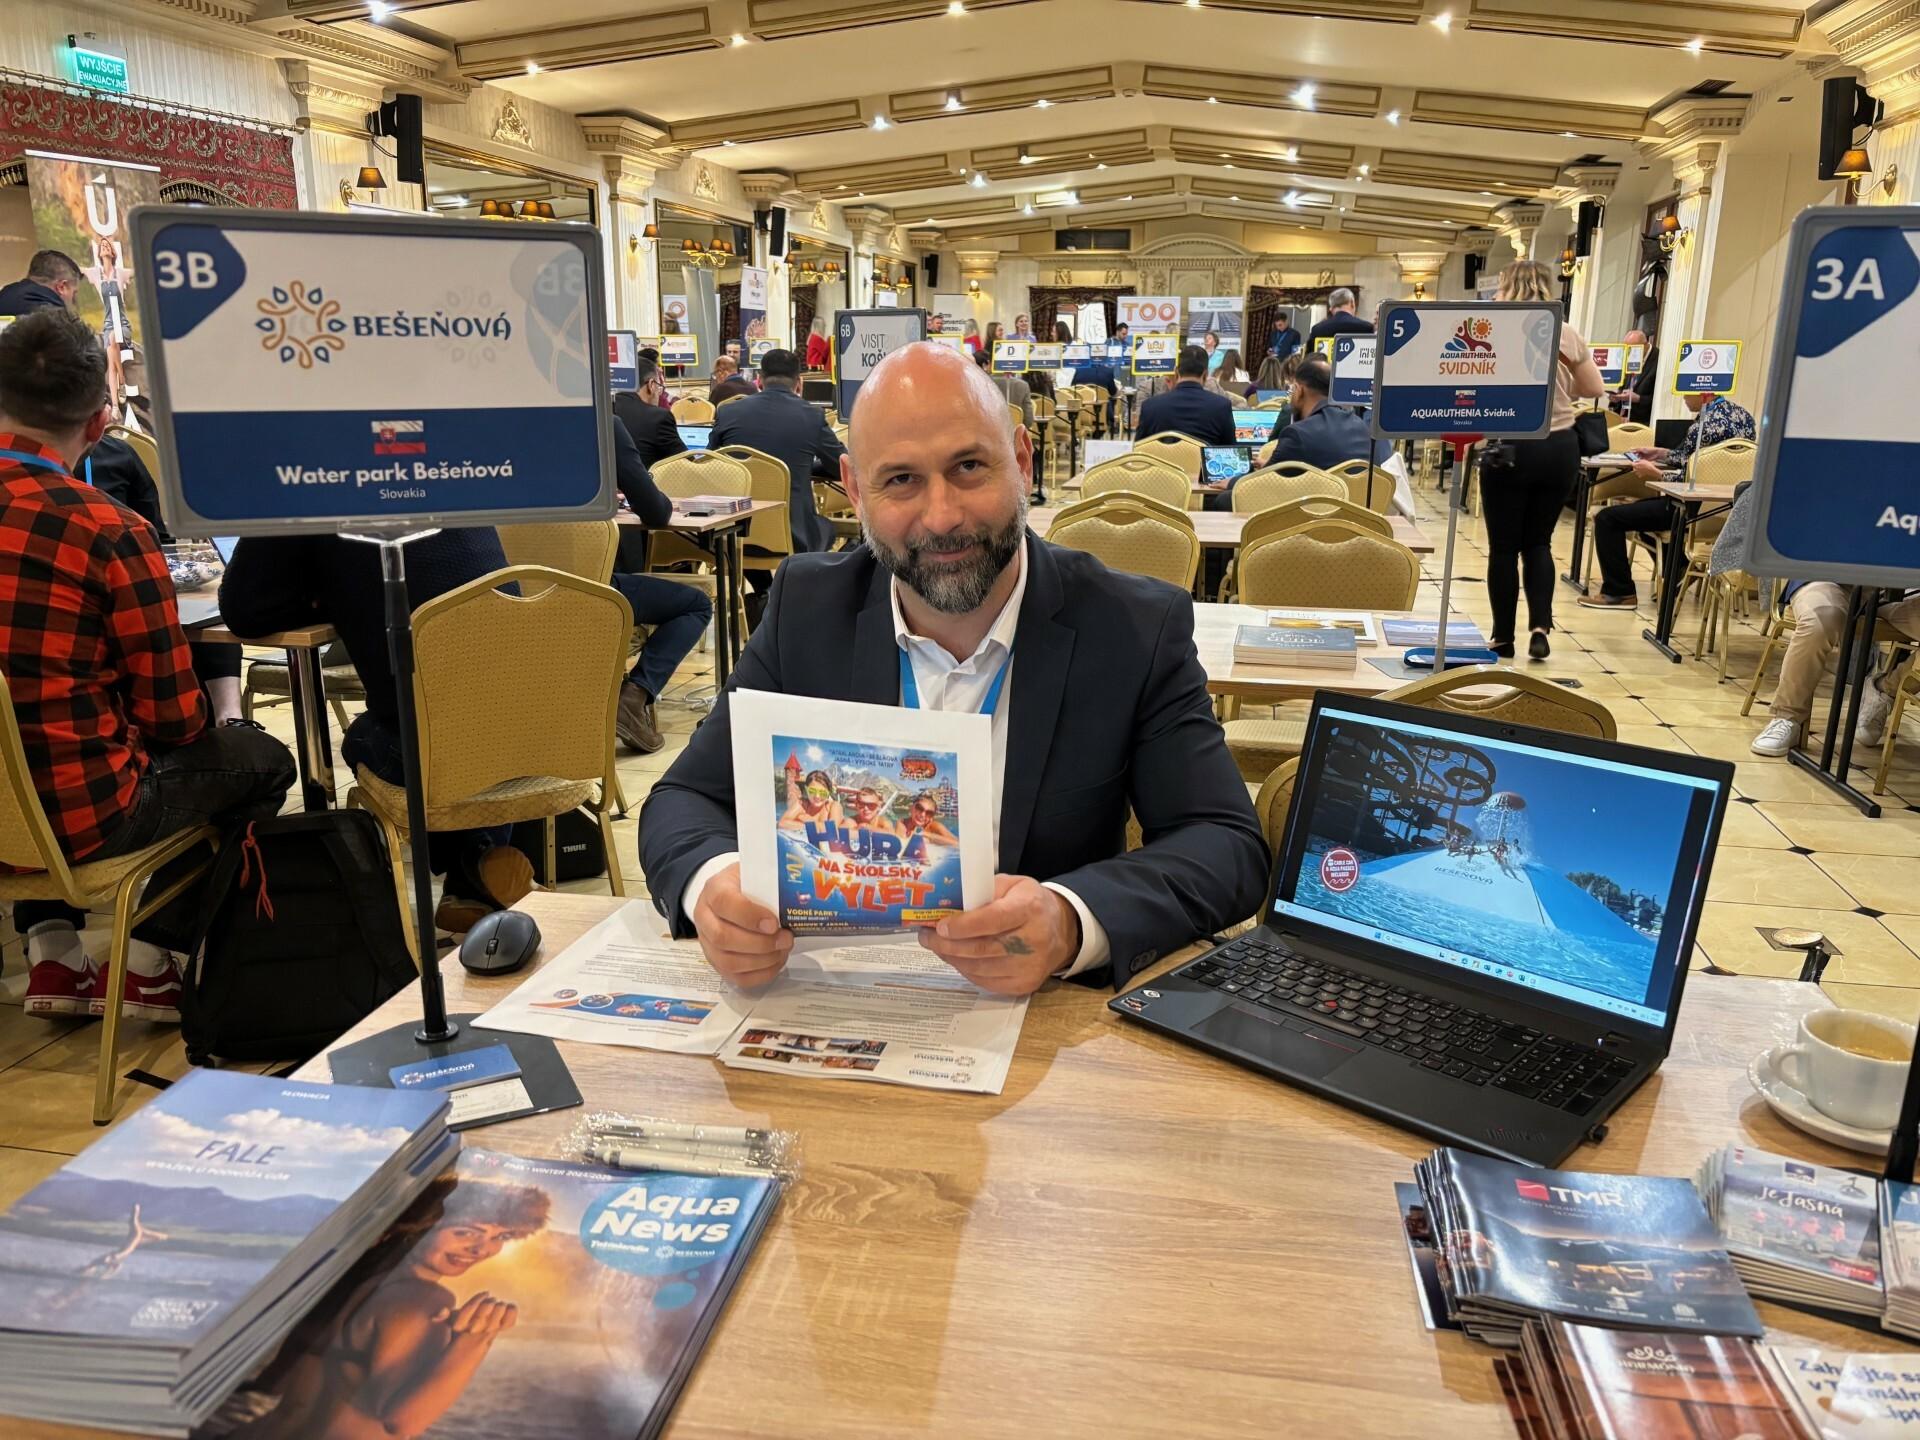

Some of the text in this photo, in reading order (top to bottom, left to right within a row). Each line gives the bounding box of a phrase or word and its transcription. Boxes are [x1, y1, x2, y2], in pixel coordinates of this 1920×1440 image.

[79, 55, 123, 76] WYJŚCIE
[156, 251, 219, 290] 3B
[1811, 258, 1885, 300] 3A
[353, 310, 512, 342] BEŠEŇOVÁ
[841, 324, 851, 337] 6B
[1392, 320, 1404, 337] 5
[861, 334, 885, 348] VISIT
[1339, 343, 1350, 352] 10
[862, 349, 887, 367] KOŠ
[1439, 359, 1496, 375] SVIDNÍK
[1411, 408, 1516, 418] AQUARUTHENIA Svidník
[276, 460, 513, 488] Water park Bešeňová
[379, 487, 427, 500] Slovakia
[562, 844, 587, 853] THULE
[805, 820, 929, 865] HURÁ
[819, 858, 922, 881] NA ŠKOLSKÝ
[813, 870, 935, 912] VÝLET
[195, 1140, 285, 1165] FALE
[608, 1186, 740, 1219] Aqua
[1550, 1187, 1628, 1207] TMR
[1779, 1191, 1843, 1218] Jasná
[590, 1210, 731, 1243] News
